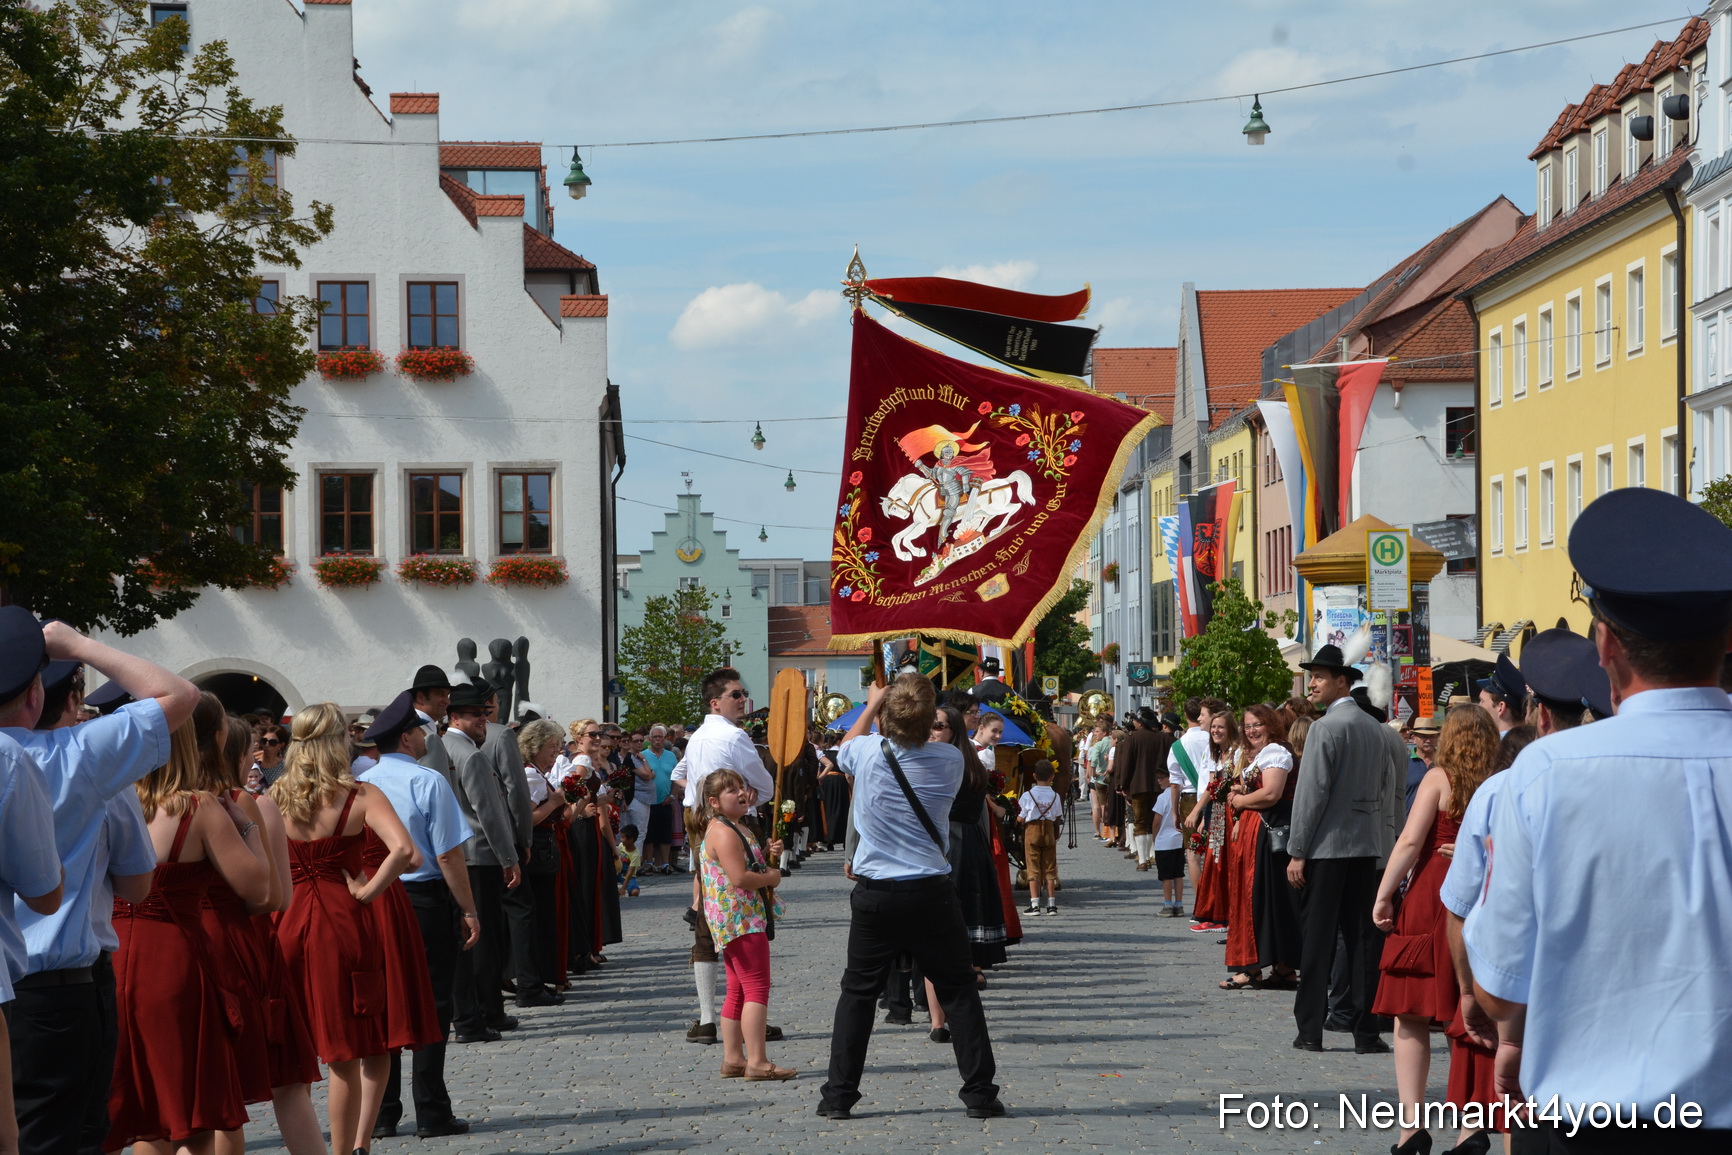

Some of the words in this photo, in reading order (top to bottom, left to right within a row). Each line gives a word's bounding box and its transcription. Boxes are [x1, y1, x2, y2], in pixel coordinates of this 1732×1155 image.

[851, 387, 909, 461] Bereitschaft
[908, 383, 935, 400] und
[937, 383, 970, 411] Mut
[1024, 512, 1049, 537] und
[1045, 482, 1068, 511] Gut
[1380, 542, 1395, 559] H
